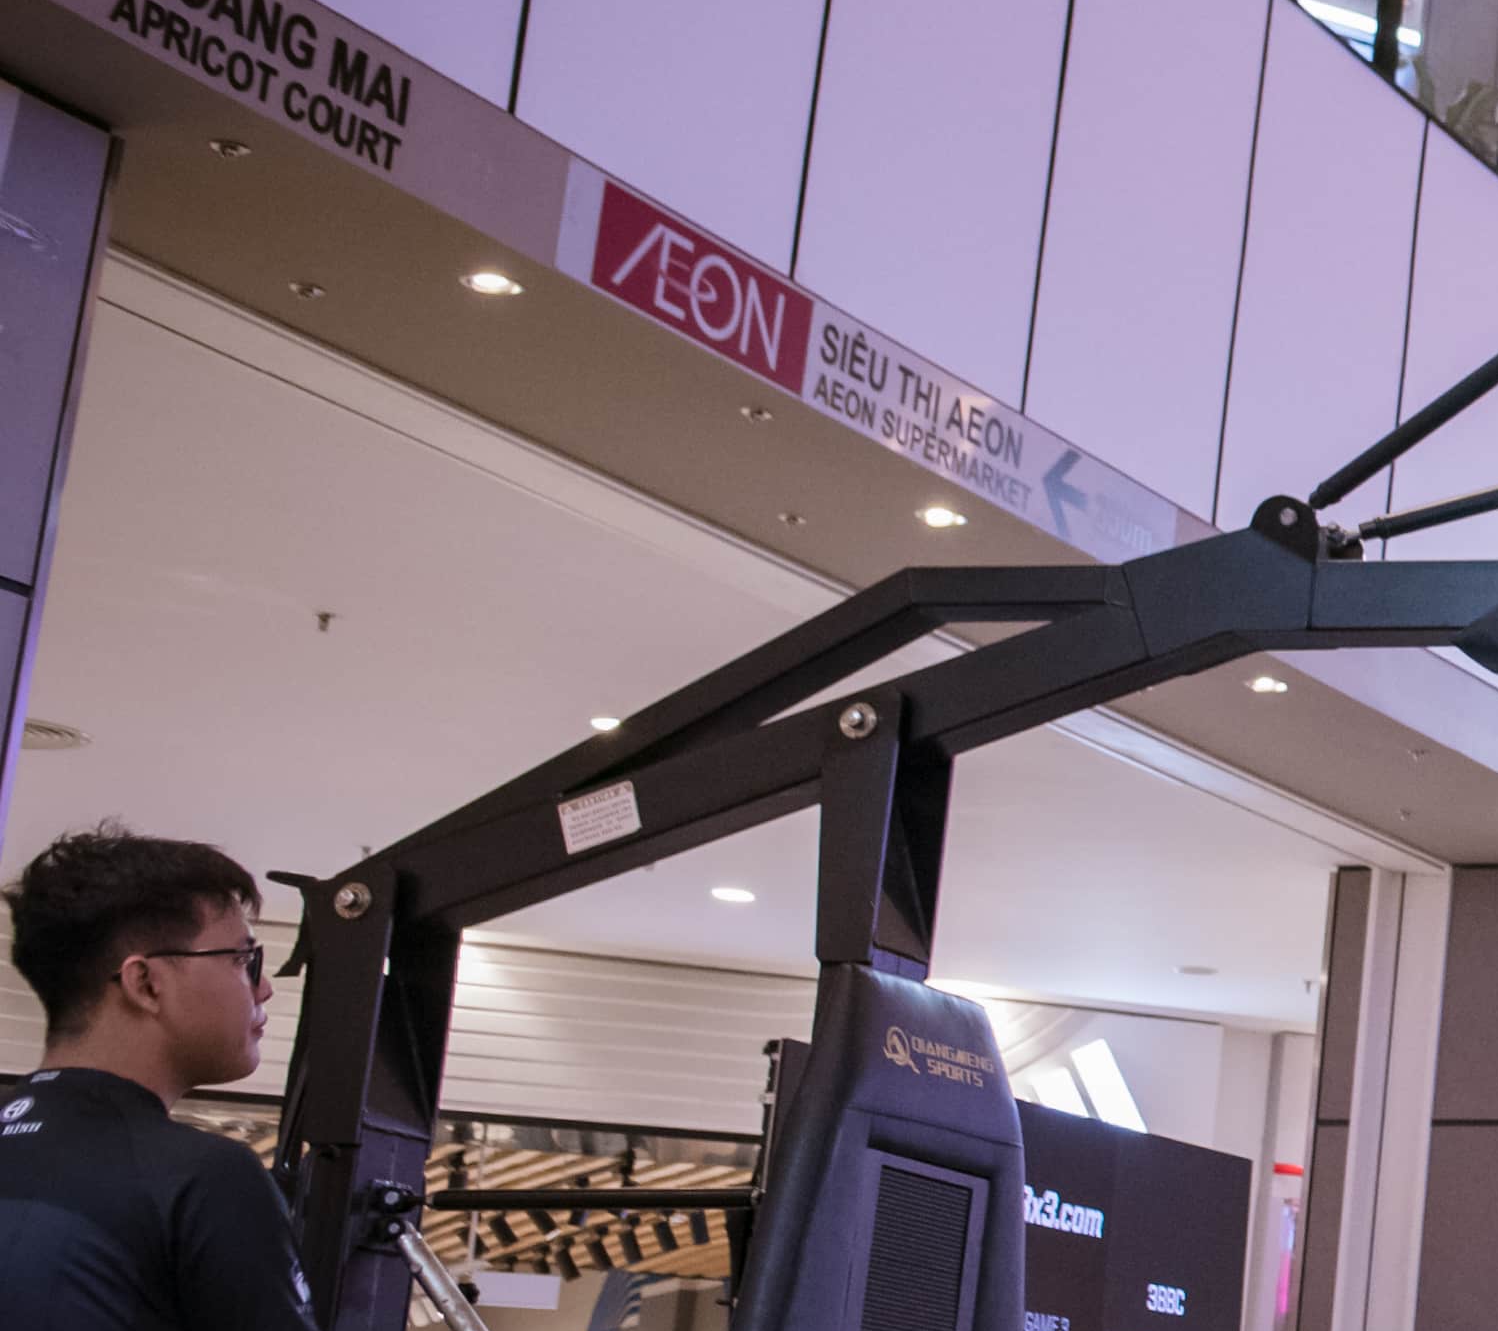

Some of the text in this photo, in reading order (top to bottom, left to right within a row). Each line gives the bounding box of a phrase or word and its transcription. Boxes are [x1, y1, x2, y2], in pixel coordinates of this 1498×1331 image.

[283, 81, 402, 170] COURT
[329, 37, 411, 127] MAI
[819, 321, 1024, 470] SIÊU THỊ AEON
[814, 372, 1033, 514] AEON SUPERMARKET
[911, 1035, 996, 1073] QIANGMENG
[927, 1058, 984, 1089] SPORTS
[1146, 1282, 1186, 1317] 3BBC
